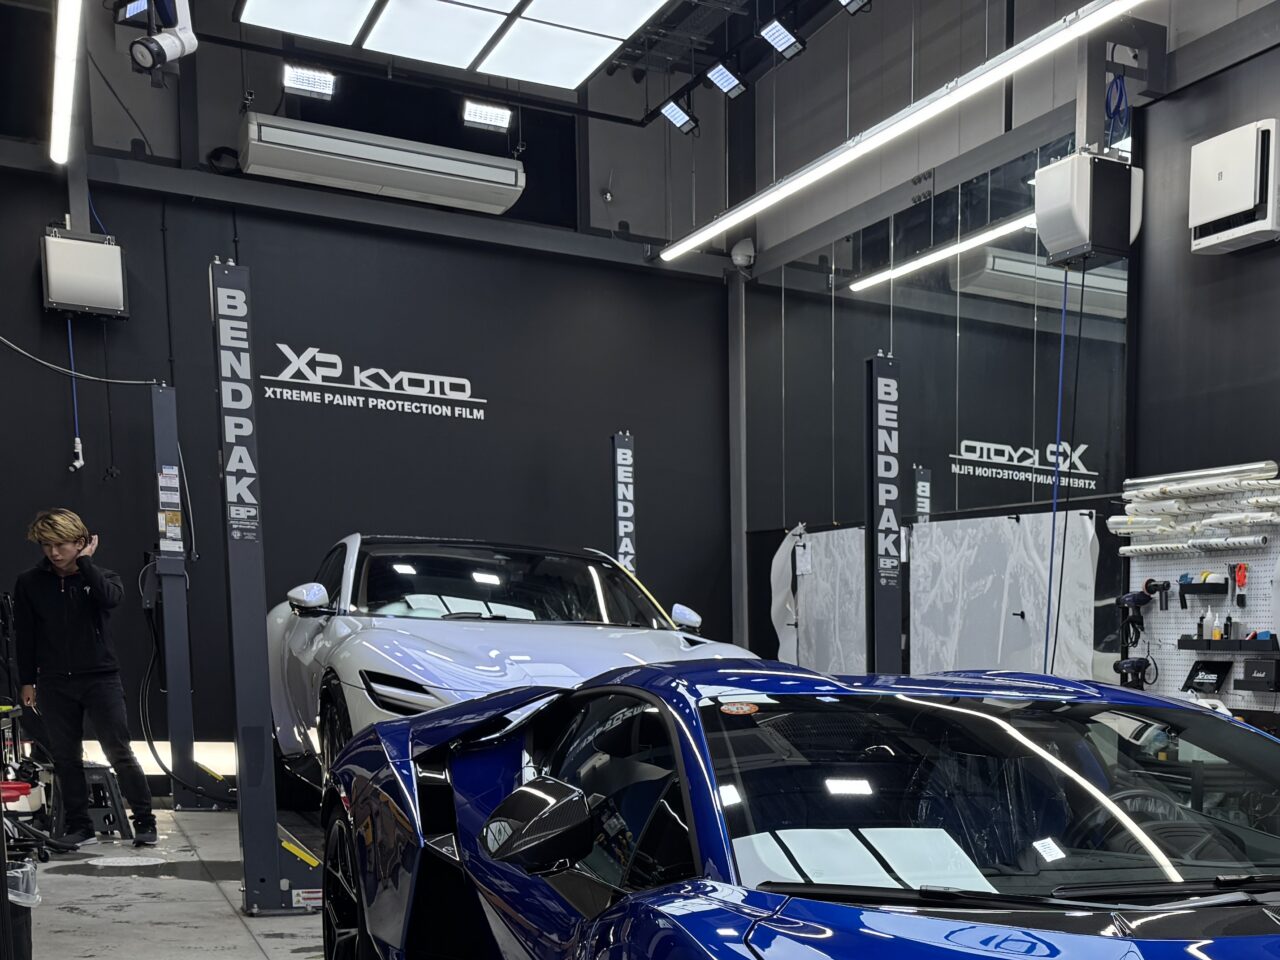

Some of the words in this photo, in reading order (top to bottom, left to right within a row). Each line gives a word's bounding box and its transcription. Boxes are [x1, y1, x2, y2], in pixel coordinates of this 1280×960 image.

[216, 287, 258, 504] BENDPAK
[276, 343, 342, 384] XP
[354, 365, 471, 399] KYOTO
[264, 386, 321, 404] XTREME
[324, 393, 364, 408] PAINT
[368, 398, 452, 417] PROTECTION
[454, 406, 485, 421] FILM
[877, 376, 899, 557] BENDPAK
[230, 506, 257, 519] BP
[616, 448, 635, 571] BENDPAK
[880, 558, 899, 569] BP
